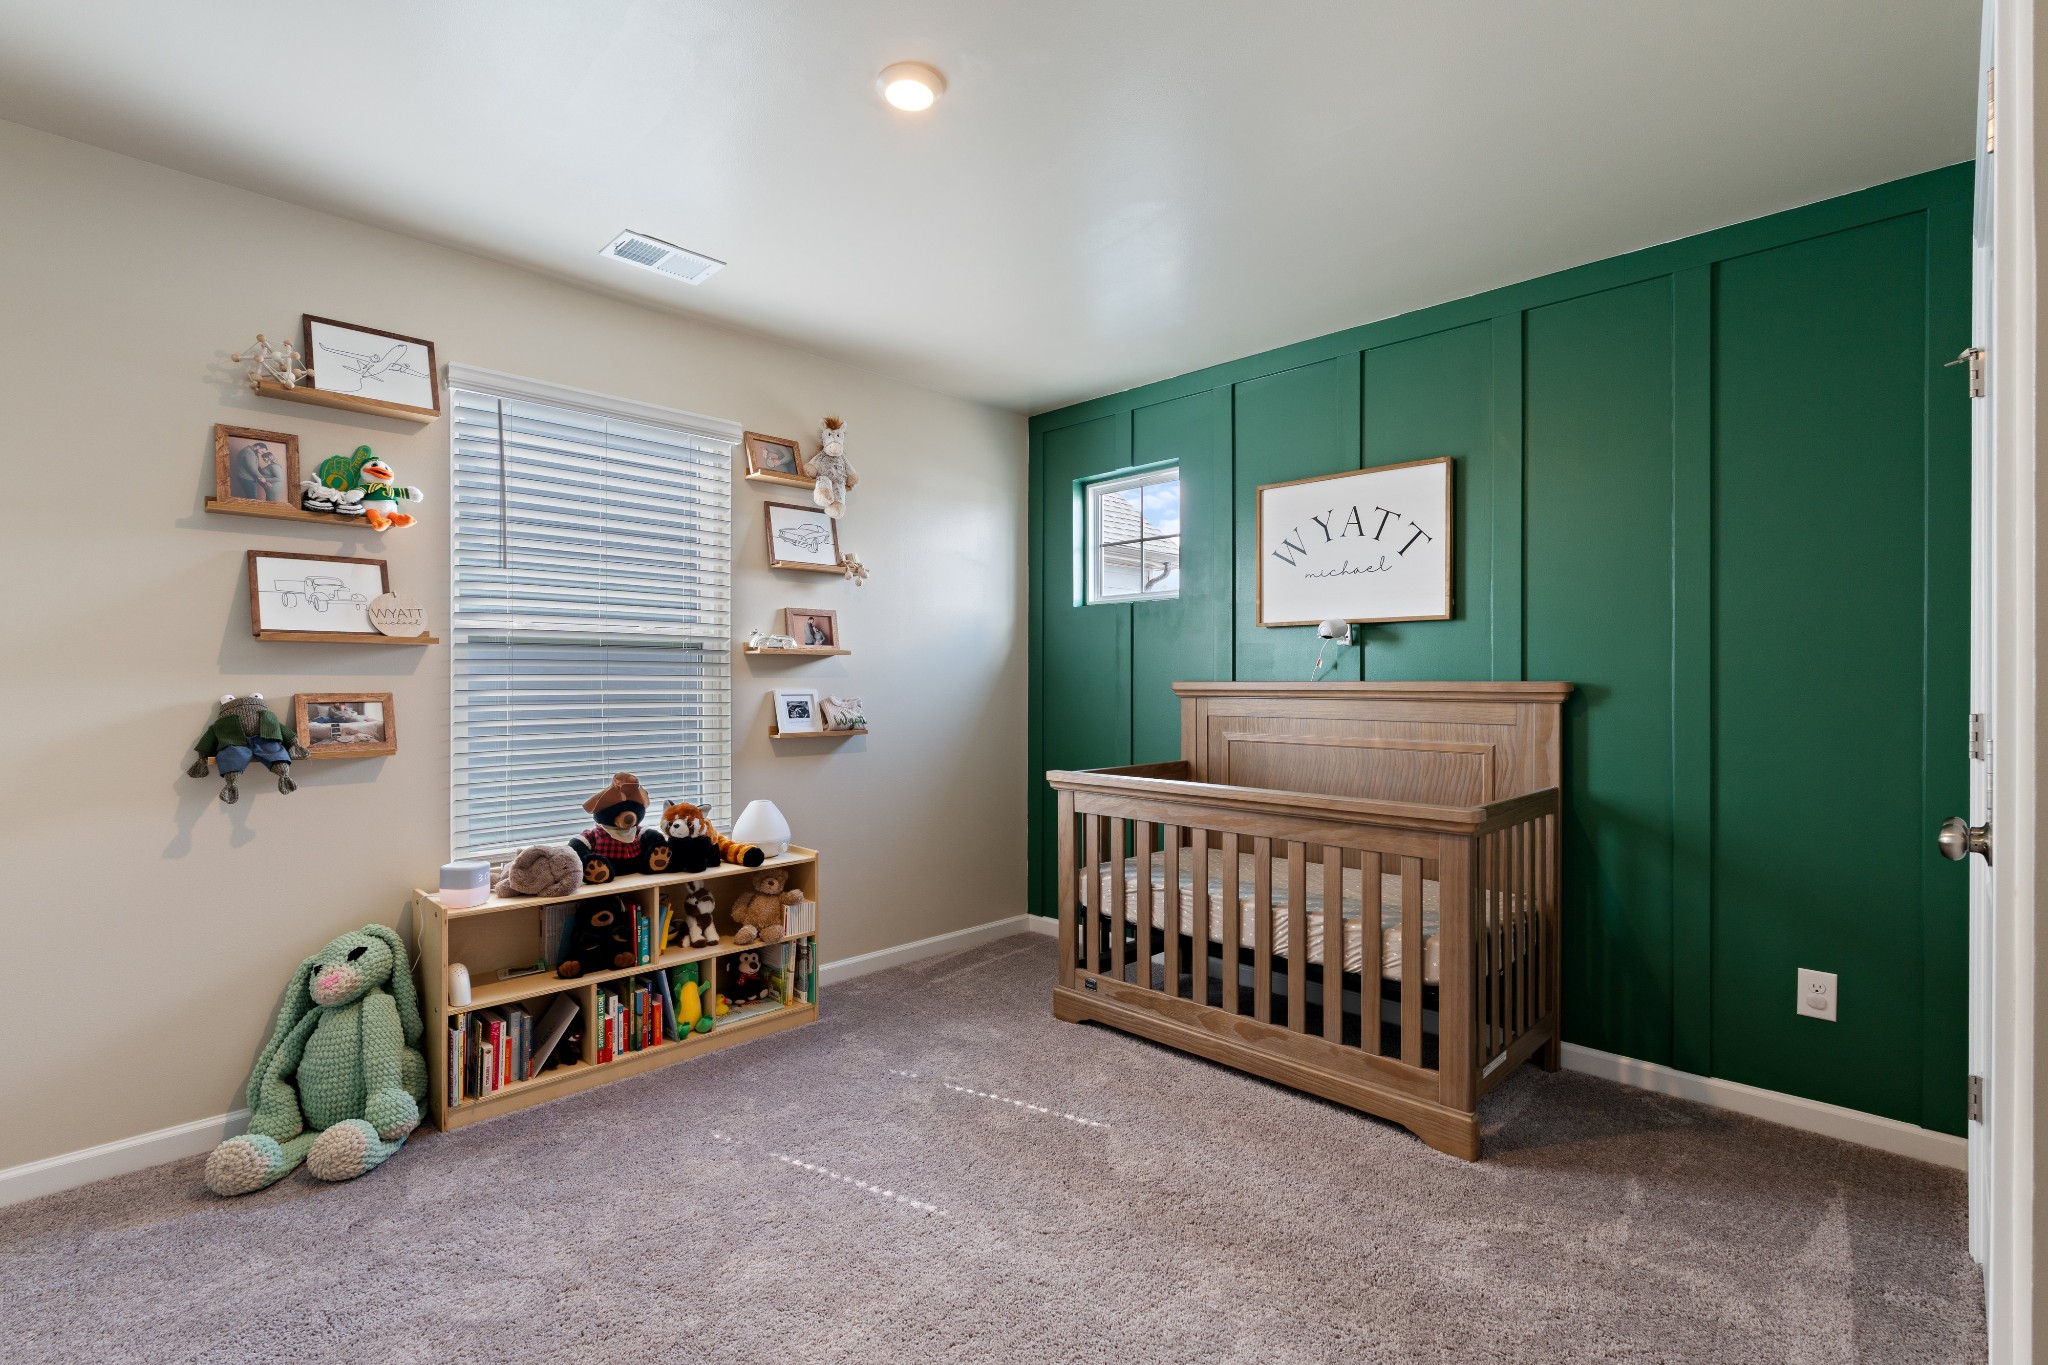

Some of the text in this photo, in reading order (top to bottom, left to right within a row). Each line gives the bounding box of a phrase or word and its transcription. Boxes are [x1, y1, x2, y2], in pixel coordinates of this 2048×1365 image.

[1272, 505, 1433, 567] WYATT
[1304, 555, 1393, 580] michael
[371, 608, 423, 618] WYATT
[377, 618, 422, 626] michael
